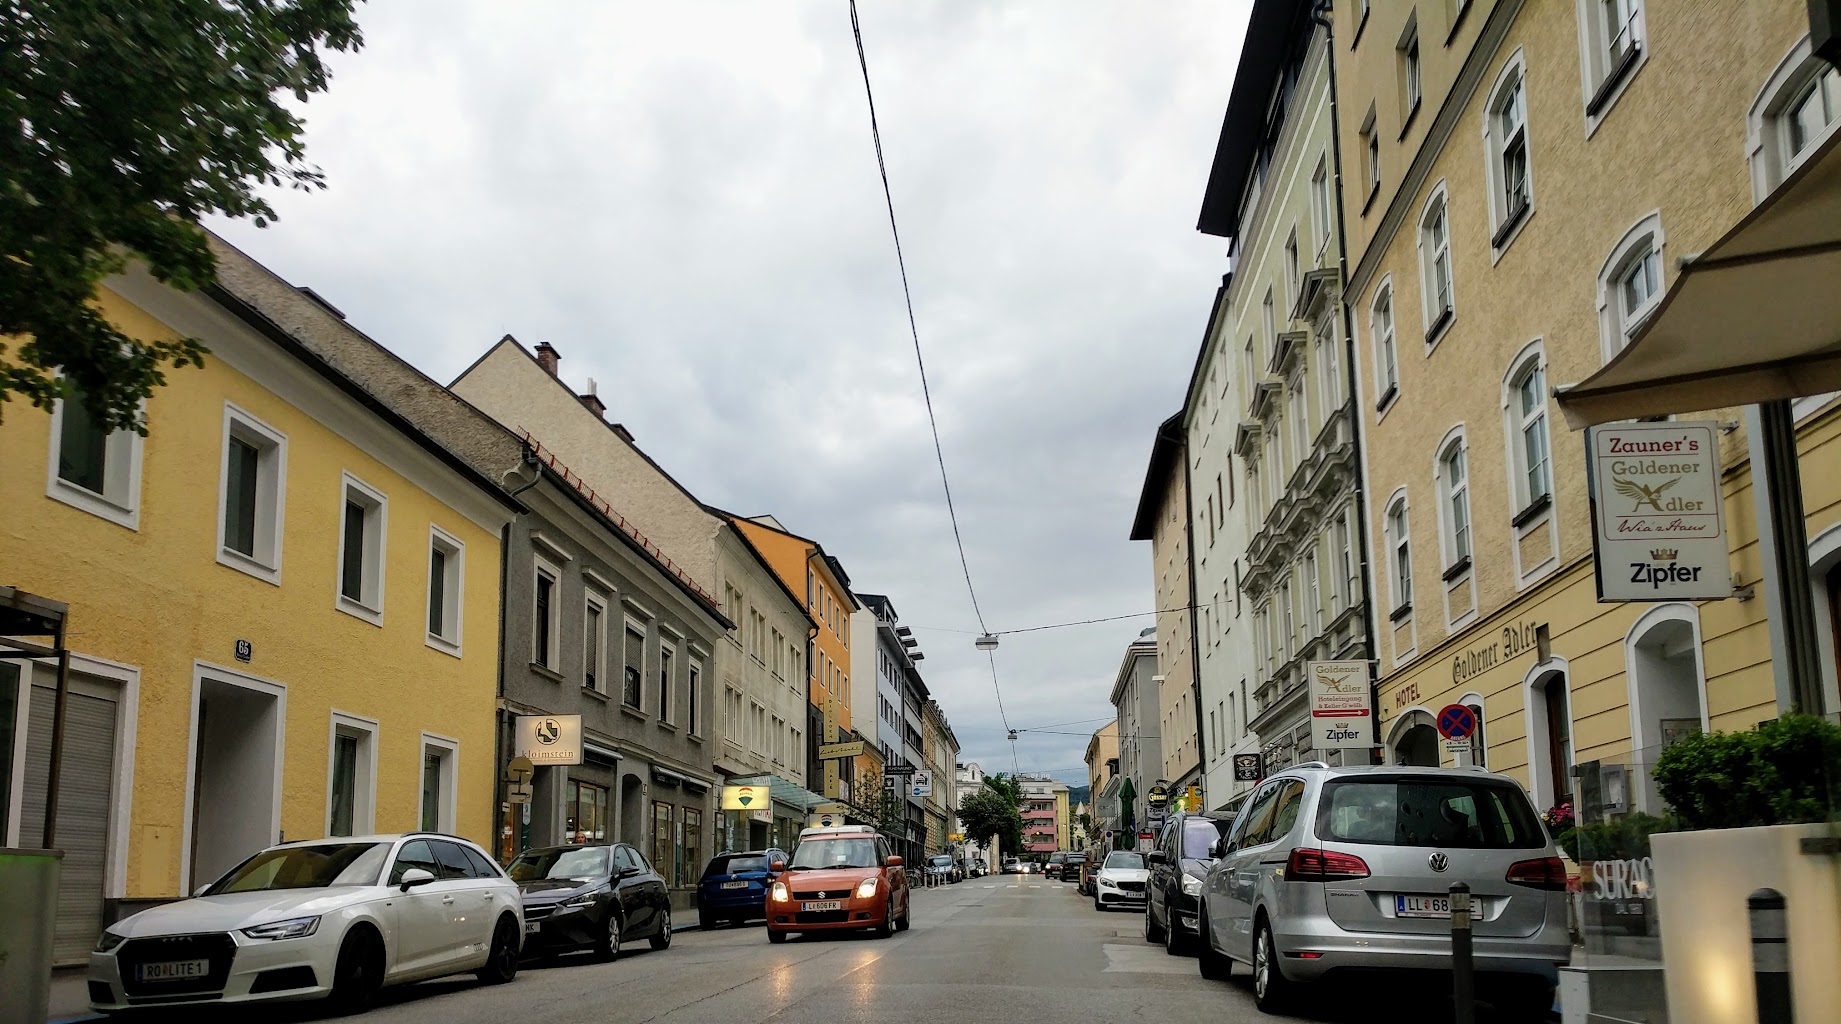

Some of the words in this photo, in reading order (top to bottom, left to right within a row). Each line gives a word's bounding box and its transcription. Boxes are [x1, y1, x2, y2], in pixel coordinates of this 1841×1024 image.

[1609, 435, 1699, 453] Zauner's
[1611, 460, 1700, 475] Goldener
[1665, 518, 1706, 532] Haus
[1630, 561, 1702, 589] Zipfer
[1452, 641, 1499, 685] Goldener
[1501, 621, 1537, 660] Adler
[1316, 665, 1360, 674] Goldener
[1395, 681, 1421, 710] HOTEL
[1326, 729, 1360, 743] Zipfer
[521, 749, 574, 759] kloimstein
[1408, 898, 1422, 911] LL
[147, 965, 161, 977] RO
[169, 962, 194, 976] LITE
